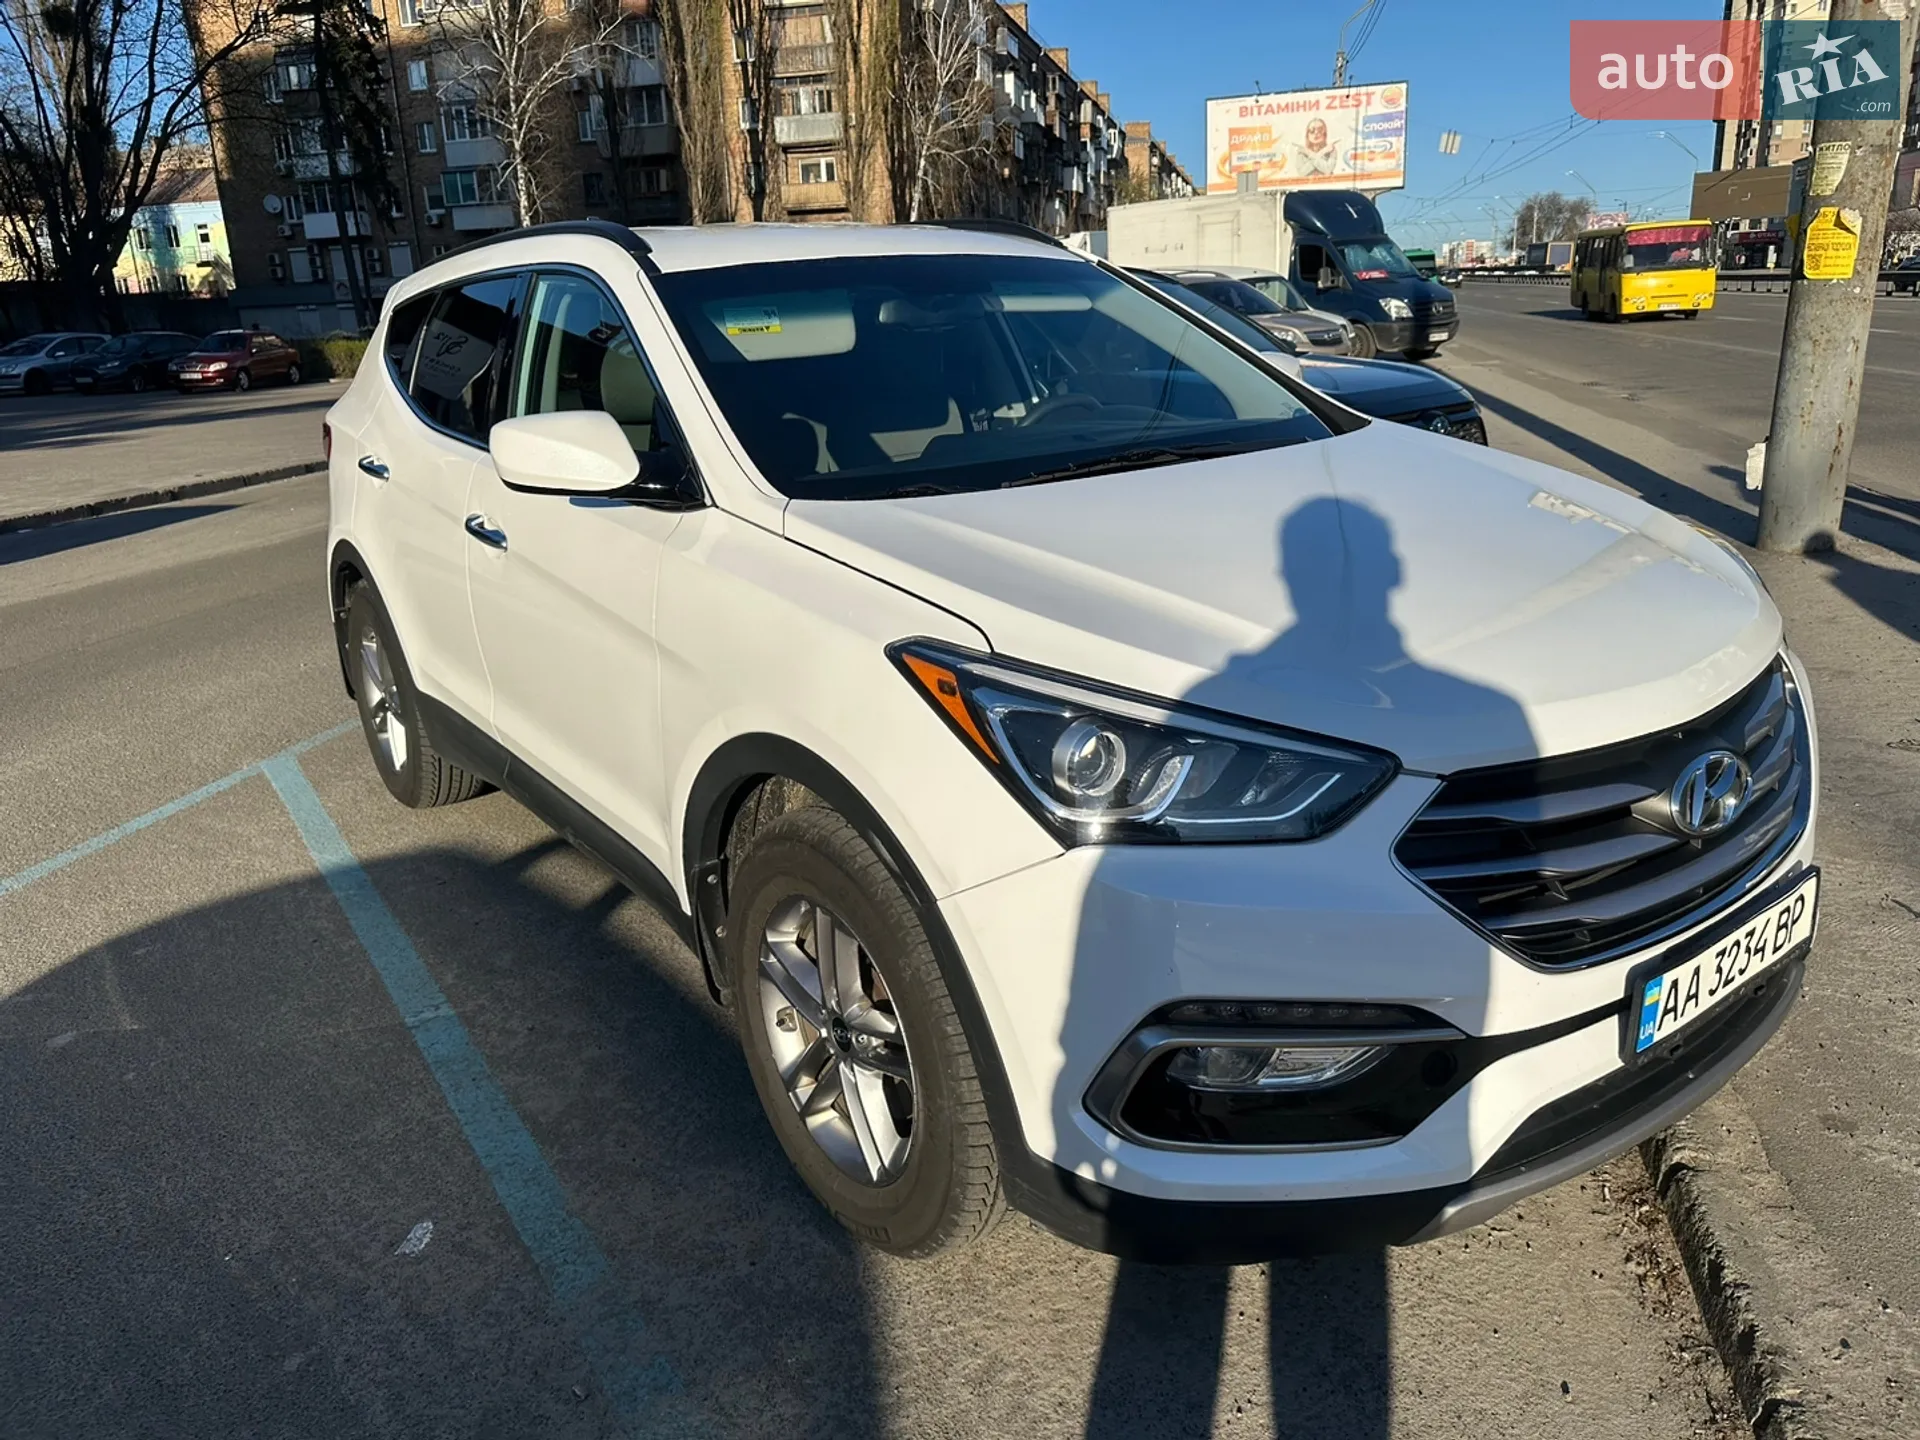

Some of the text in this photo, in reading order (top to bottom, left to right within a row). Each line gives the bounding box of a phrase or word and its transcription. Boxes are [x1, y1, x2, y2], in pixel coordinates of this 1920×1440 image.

[1239, 91, 1376, 118] ВІТАМІНИ ZEST
[1656, 893, 1805, 1032] AA 3234 BP
[1639, 1020, 1654, 1040] UA
